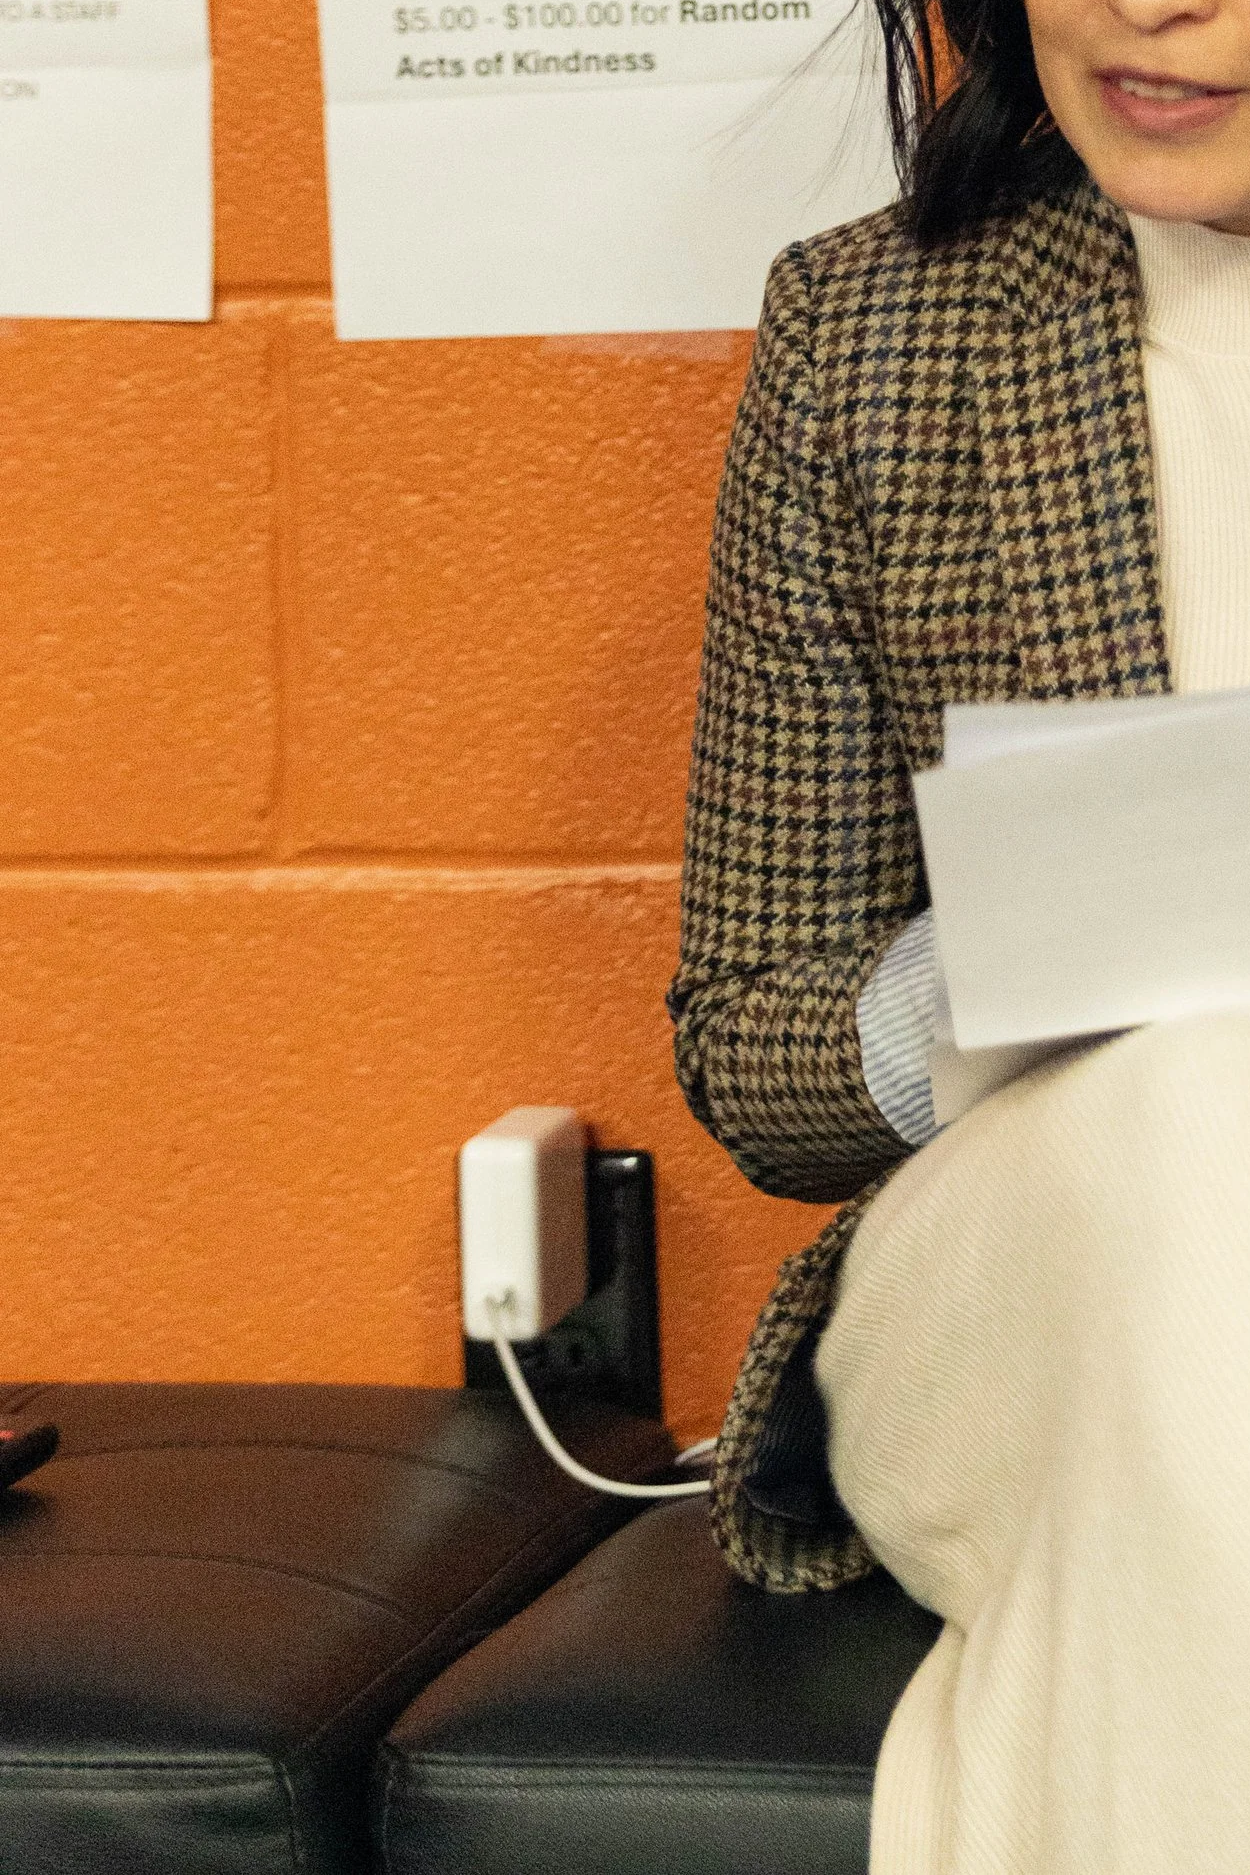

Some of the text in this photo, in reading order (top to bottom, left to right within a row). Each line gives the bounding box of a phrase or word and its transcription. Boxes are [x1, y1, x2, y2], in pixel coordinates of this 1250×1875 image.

[394, 6, 477, 35] $5.00
[504, 1, 623, 30] $100.00
[630, 0, 669, 26] for
[396, 49, 657, 79] Acts of Kindness
